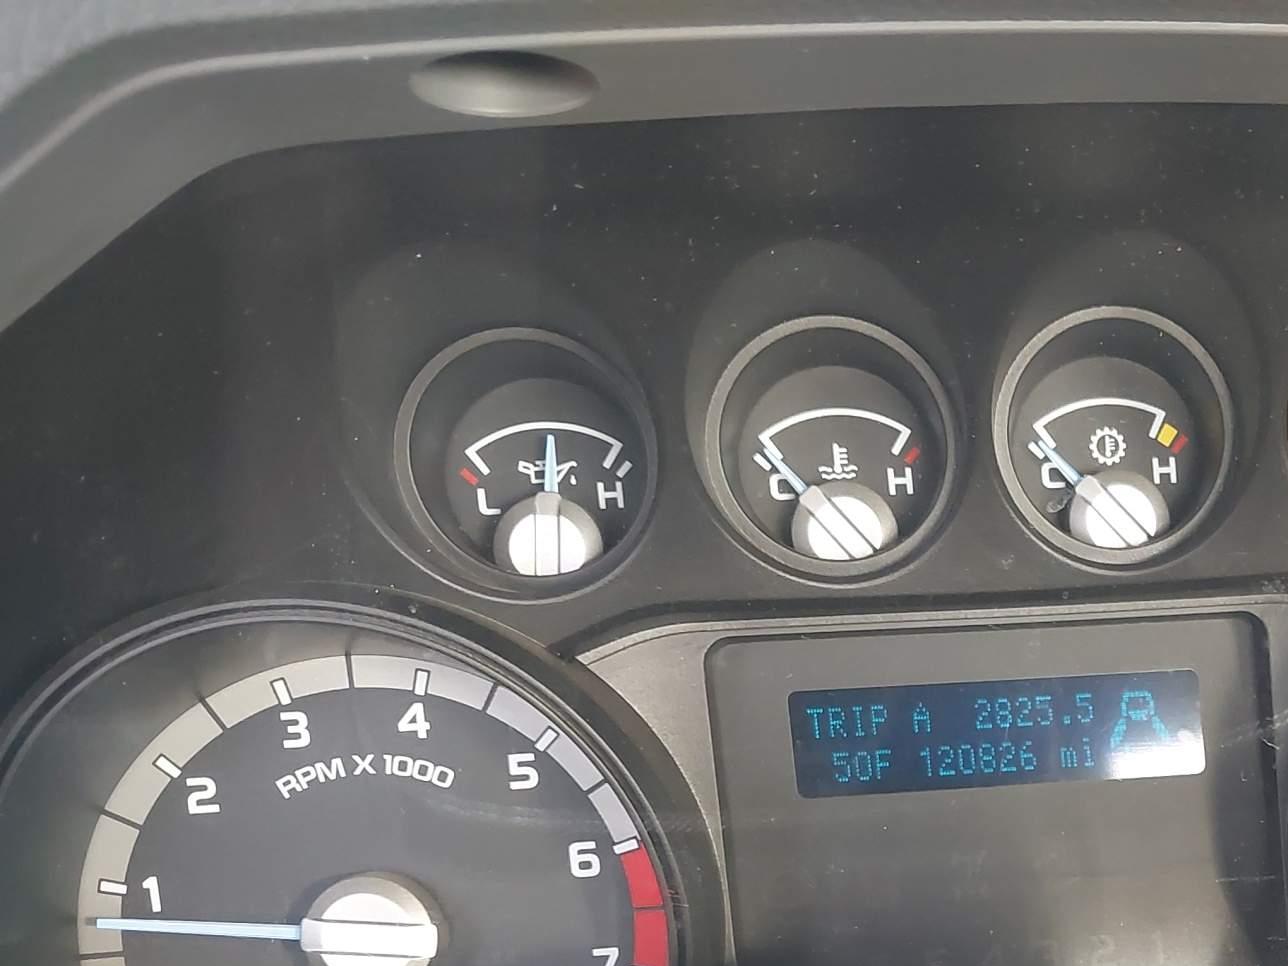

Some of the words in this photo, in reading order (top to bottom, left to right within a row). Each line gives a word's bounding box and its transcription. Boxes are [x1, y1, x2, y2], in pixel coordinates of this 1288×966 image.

[769, 473, 797, 501] C
[887, 467, 914, 496] H
[1041, 462, 1067, 489] C
[1152, 457, 1177, 484] H
[477, 488, 501, 516] L
[597, 481, 624, 509] H
[279, 711, 312, 749] 3
[397, 702, 430, 739] 4
[807, 704, 887, 739] TRIP
[913, 702, 931, 733] A
[974, 693, 1094, 730] 2825.5
[274, 757, 346, 799] RPM
[351, 754, 378, 776] X
[383, 753, 455, 789] 1000
[508, 753, 539, 791] 5
[832, 750, 892, 782] 50F
[920, 741, 1037, 777] 120826
[1061, 738, 1095, 768] mi
[186, 777, 220, 814] 2
[569, 841, 601, 878] 6
[142, 876, 163, 912] 1
